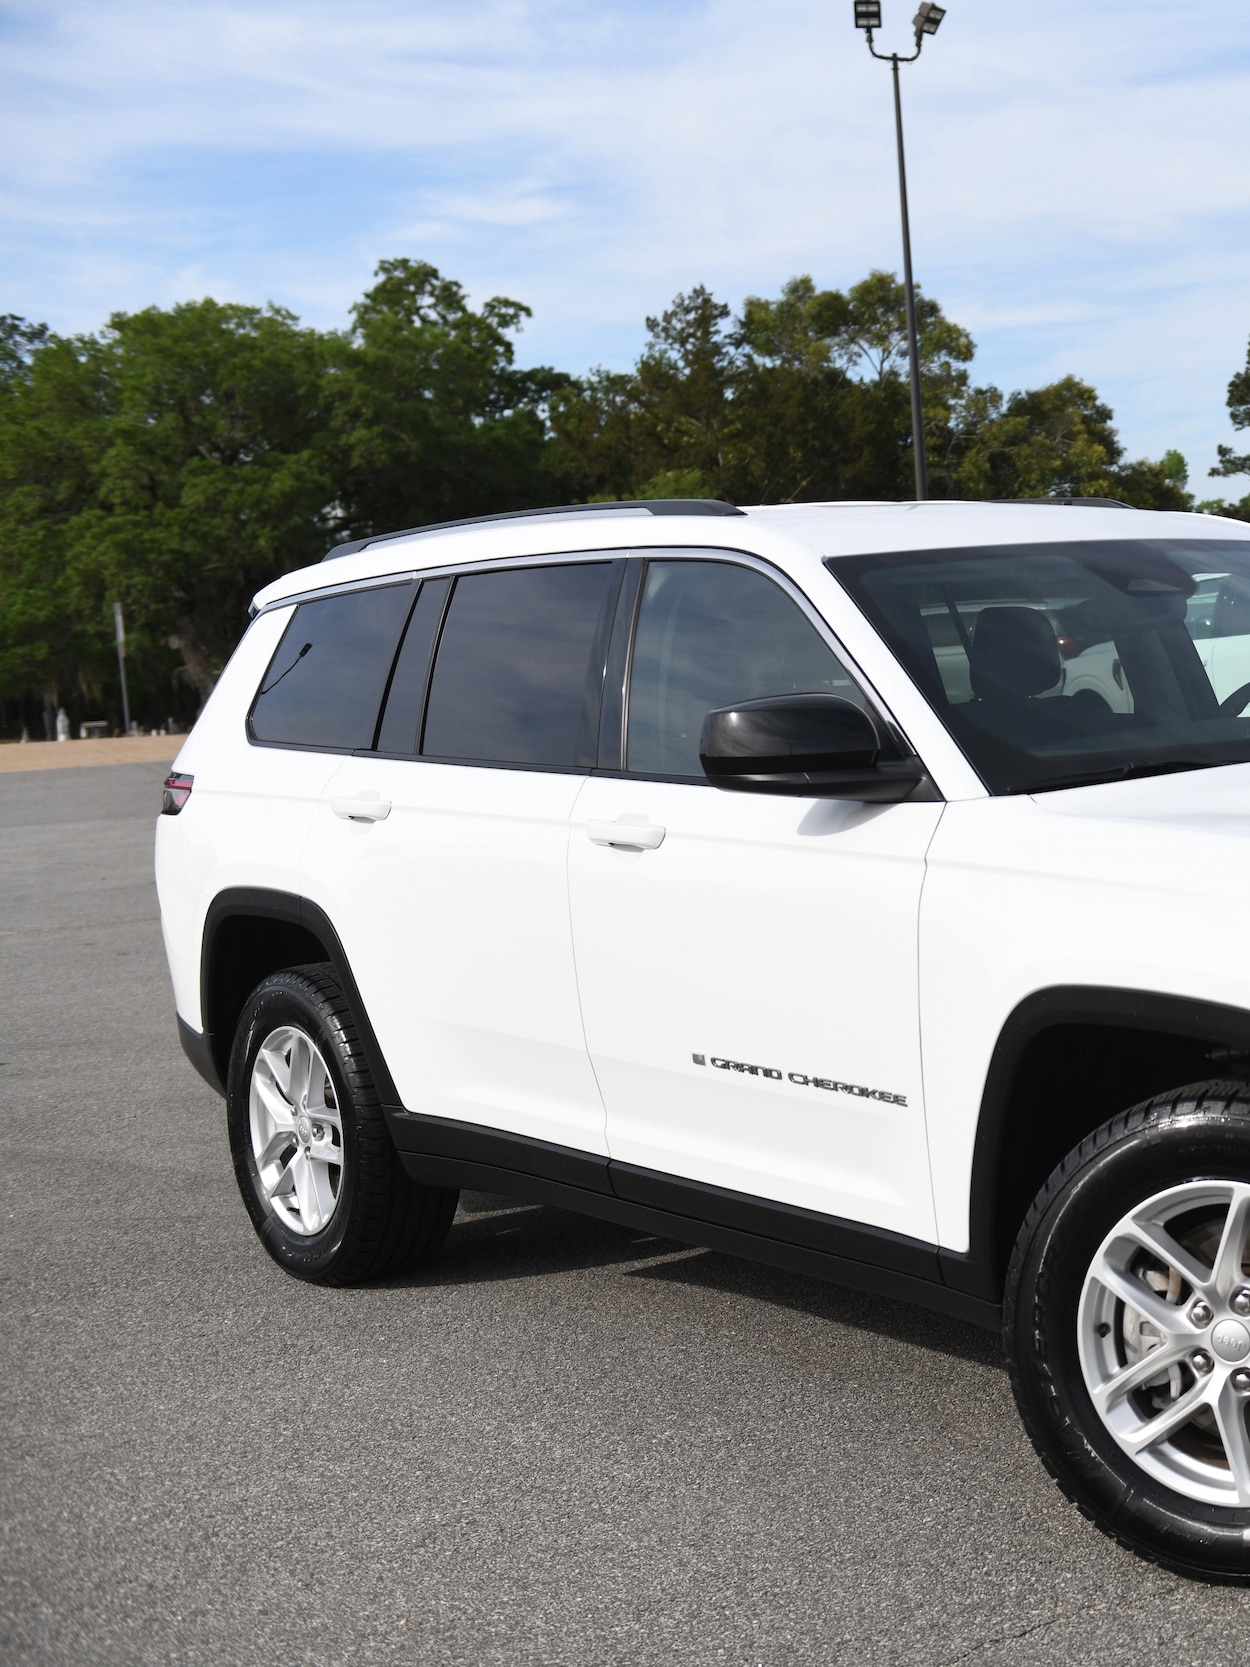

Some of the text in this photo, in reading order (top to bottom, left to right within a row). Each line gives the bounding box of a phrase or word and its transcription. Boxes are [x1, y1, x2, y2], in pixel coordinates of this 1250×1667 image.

[710, 1057, 783, 1080] GRAND
[788, 1072, 909, 1107] CHEROKEE
[1217, 1332, 1243, 1352] Jeep
